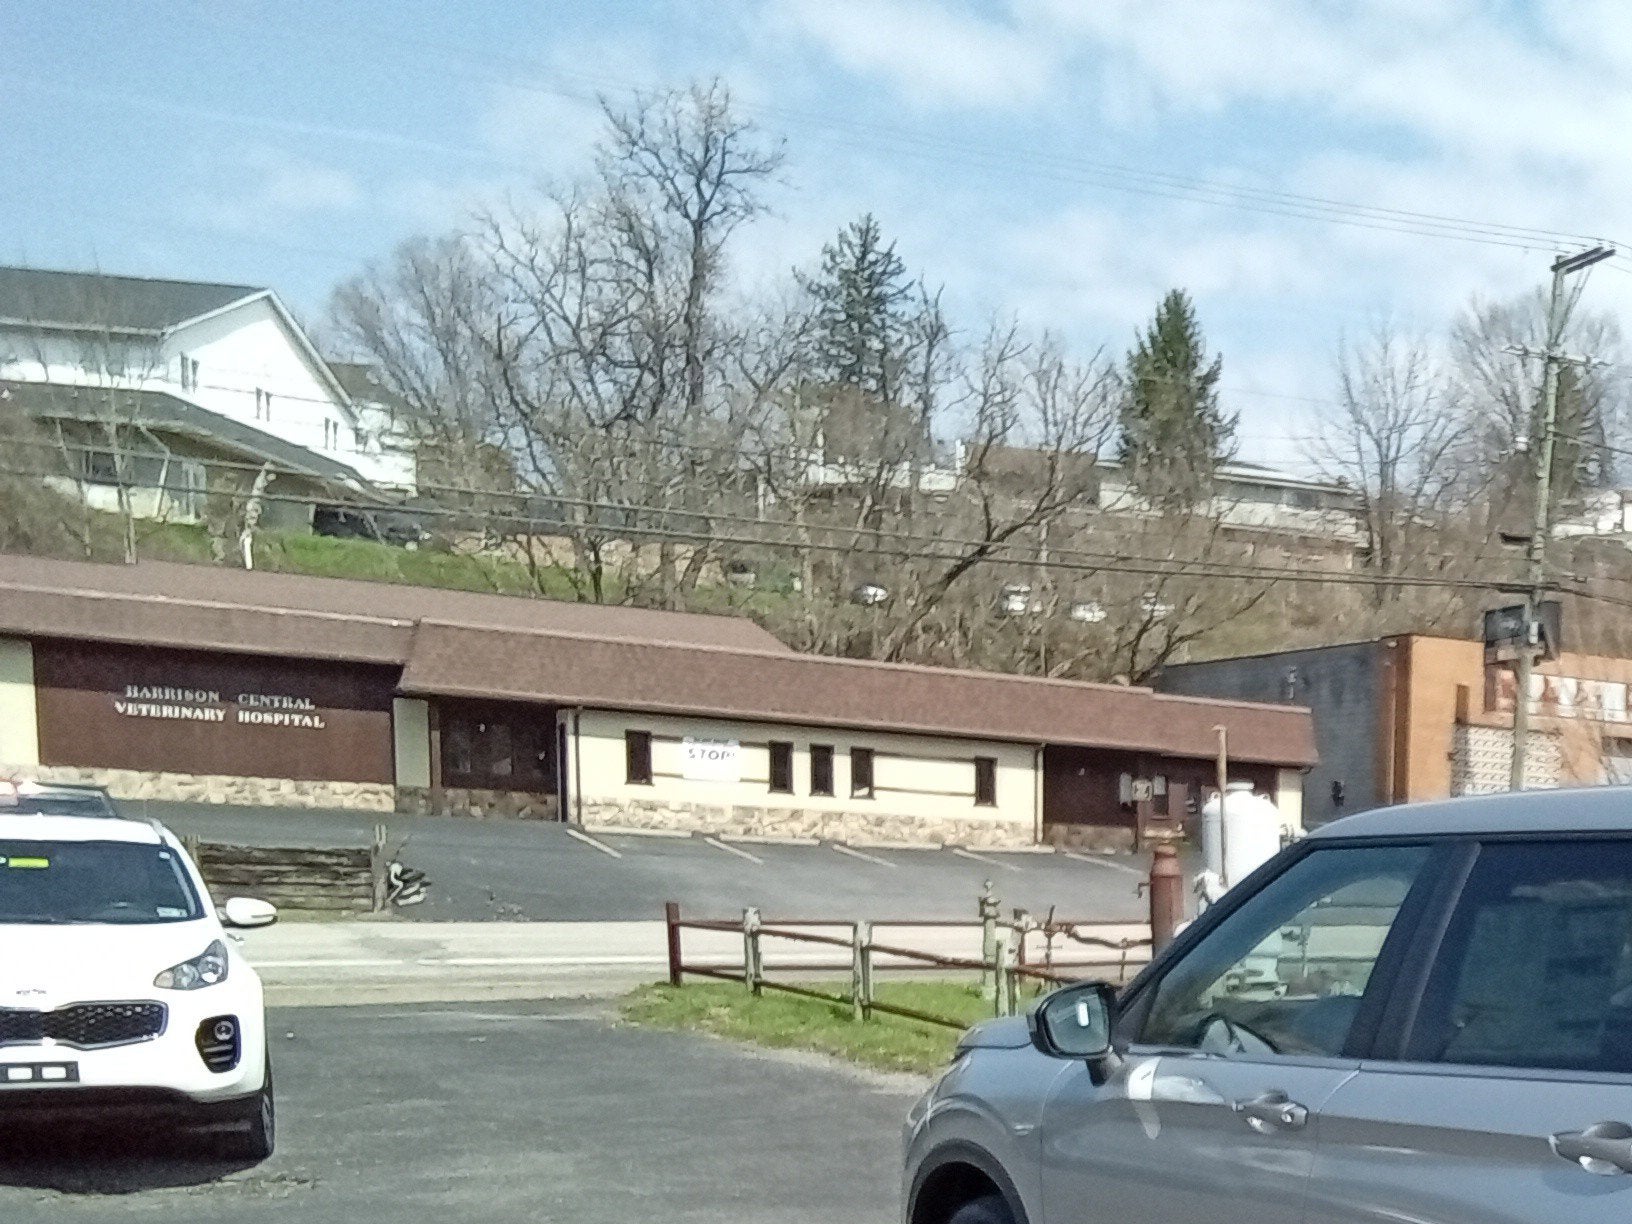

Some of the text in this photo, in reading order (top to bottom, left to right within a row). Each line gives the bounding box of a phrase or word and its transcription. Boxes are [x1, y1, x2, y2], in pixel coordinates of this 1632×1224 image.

[125, 685, 315, 710] HARRISON CENTRAL
[114, 701, 325, 728] VETERINARY HOSPITAL
